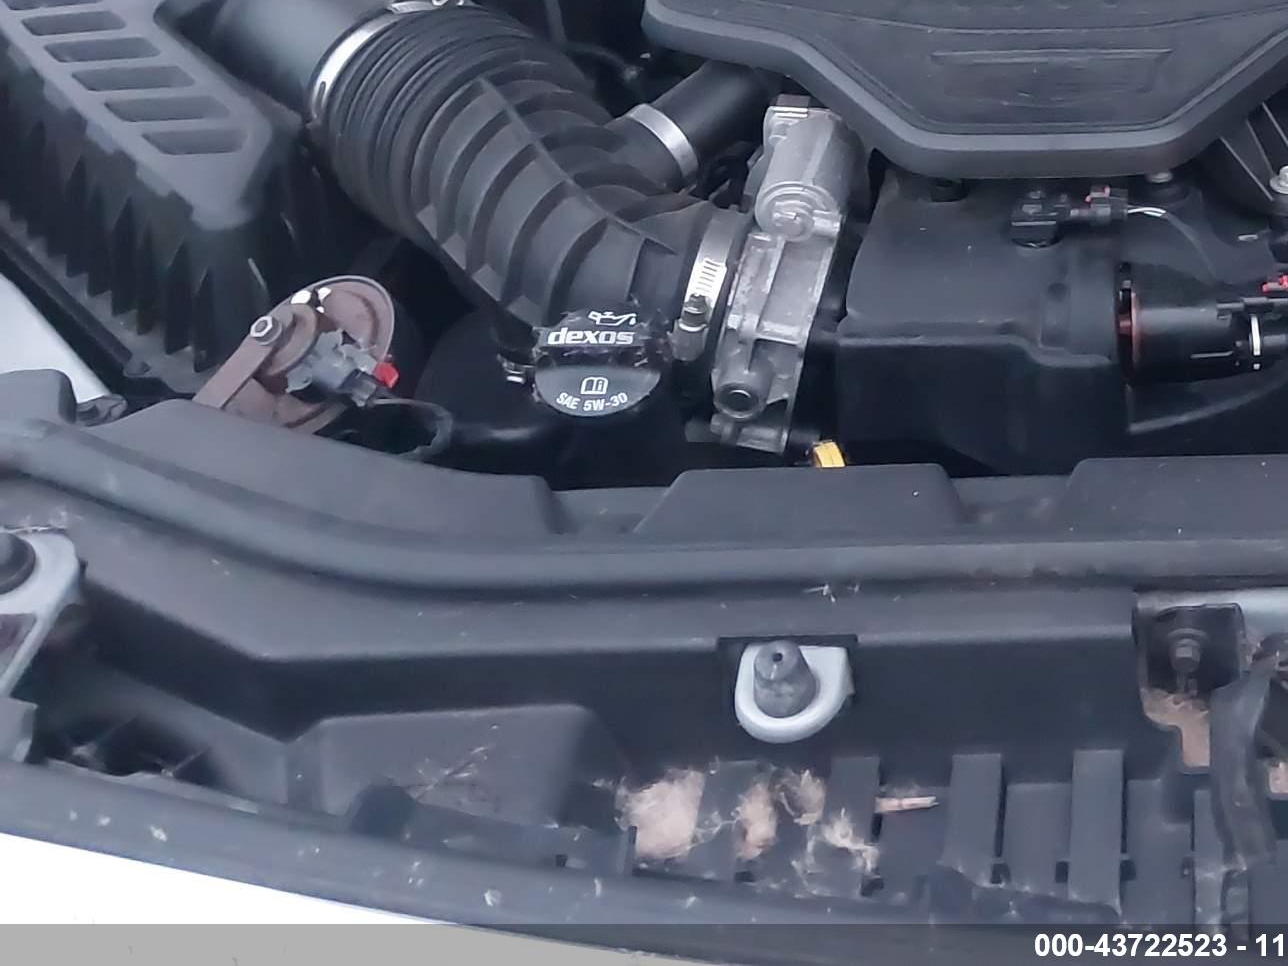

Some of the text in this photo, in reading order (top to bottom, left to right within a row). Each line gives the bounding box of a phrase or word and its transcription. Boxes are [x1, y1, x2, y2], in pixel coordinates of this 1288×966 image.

[547, 327, 634, 345] dexos
[556, 392, 628, 411] SAE 5W-30
